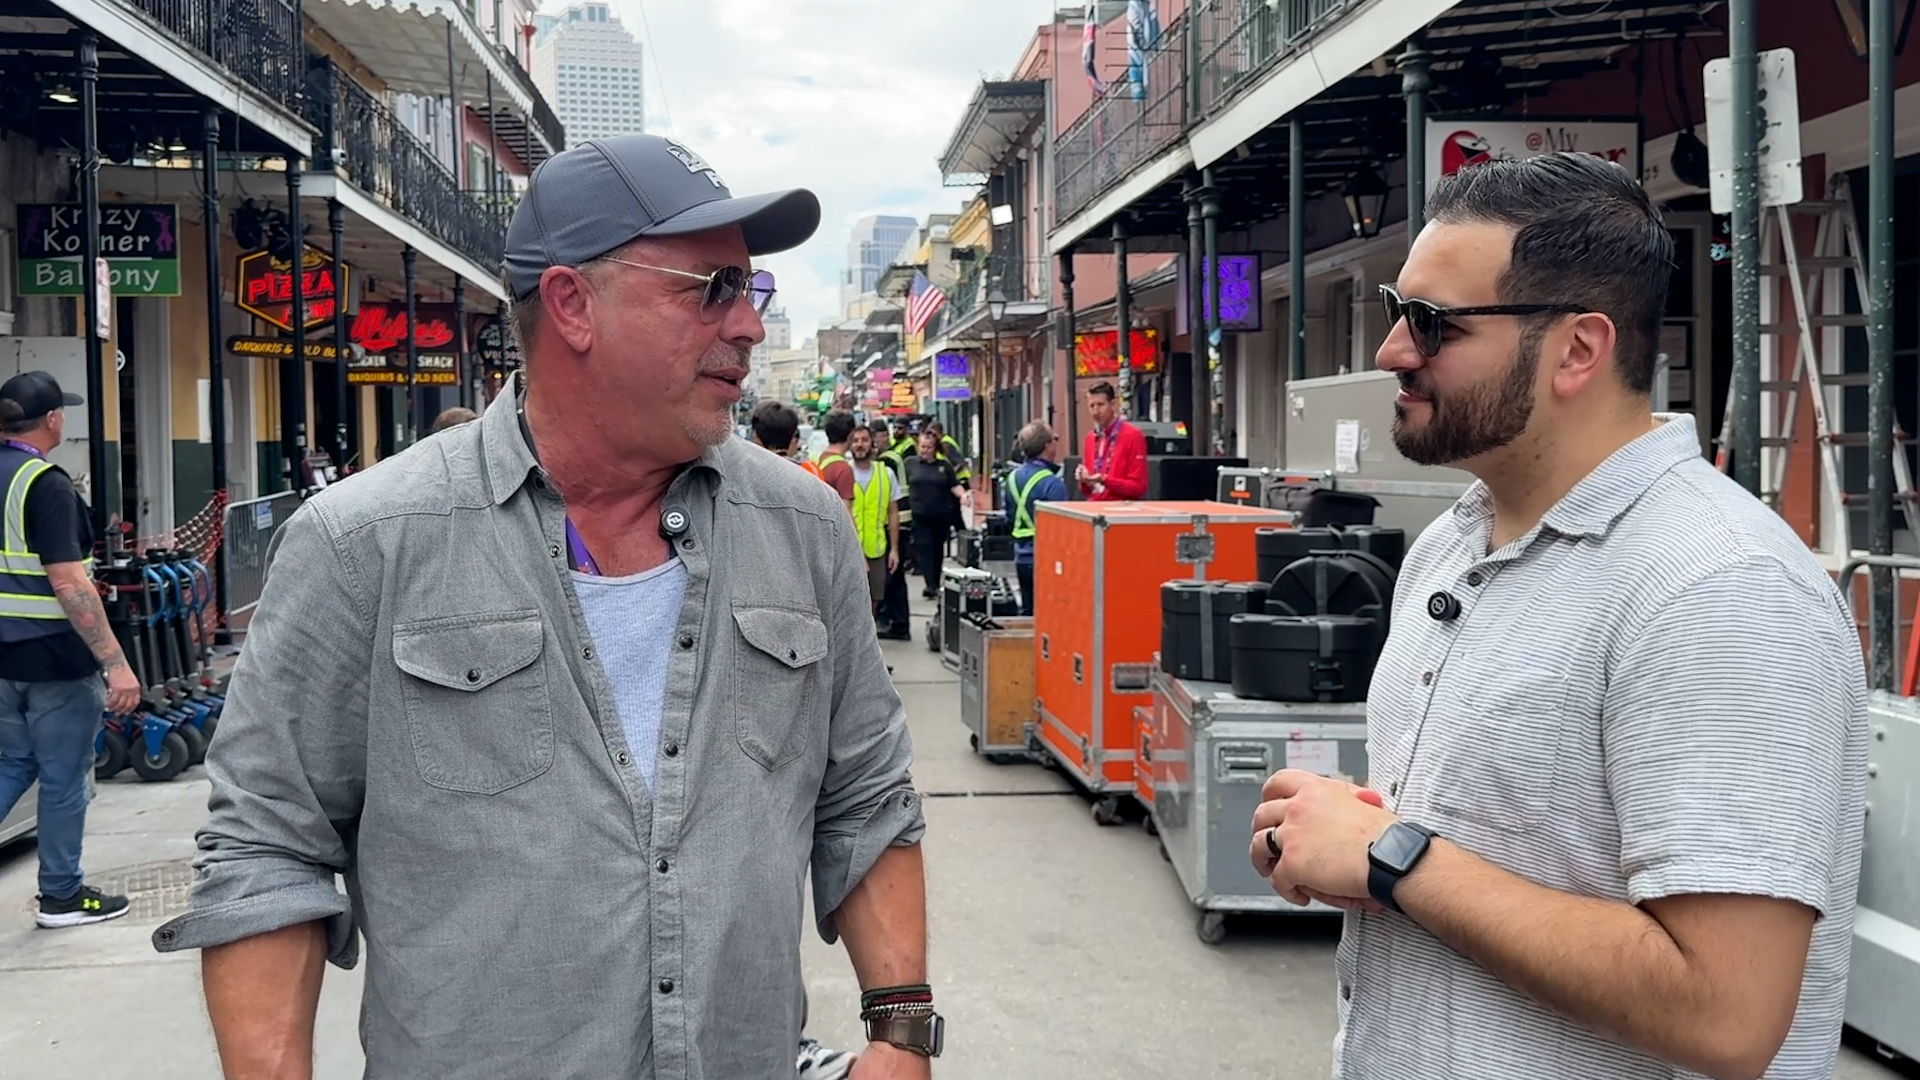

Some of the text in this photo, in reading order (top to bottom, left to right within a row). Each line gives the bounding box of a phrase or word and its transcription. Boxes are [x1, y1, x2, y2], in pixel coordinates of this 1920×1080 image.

[51, 206, 141, 231] Krzy
[43, 229, 150, 252] Koner
[35, 263, 160, 292] Balony
[248, 270, 335, 303] PIZZA
[322, 347, 350, 359] BER
[417, 355, 454, 368] SHACK
